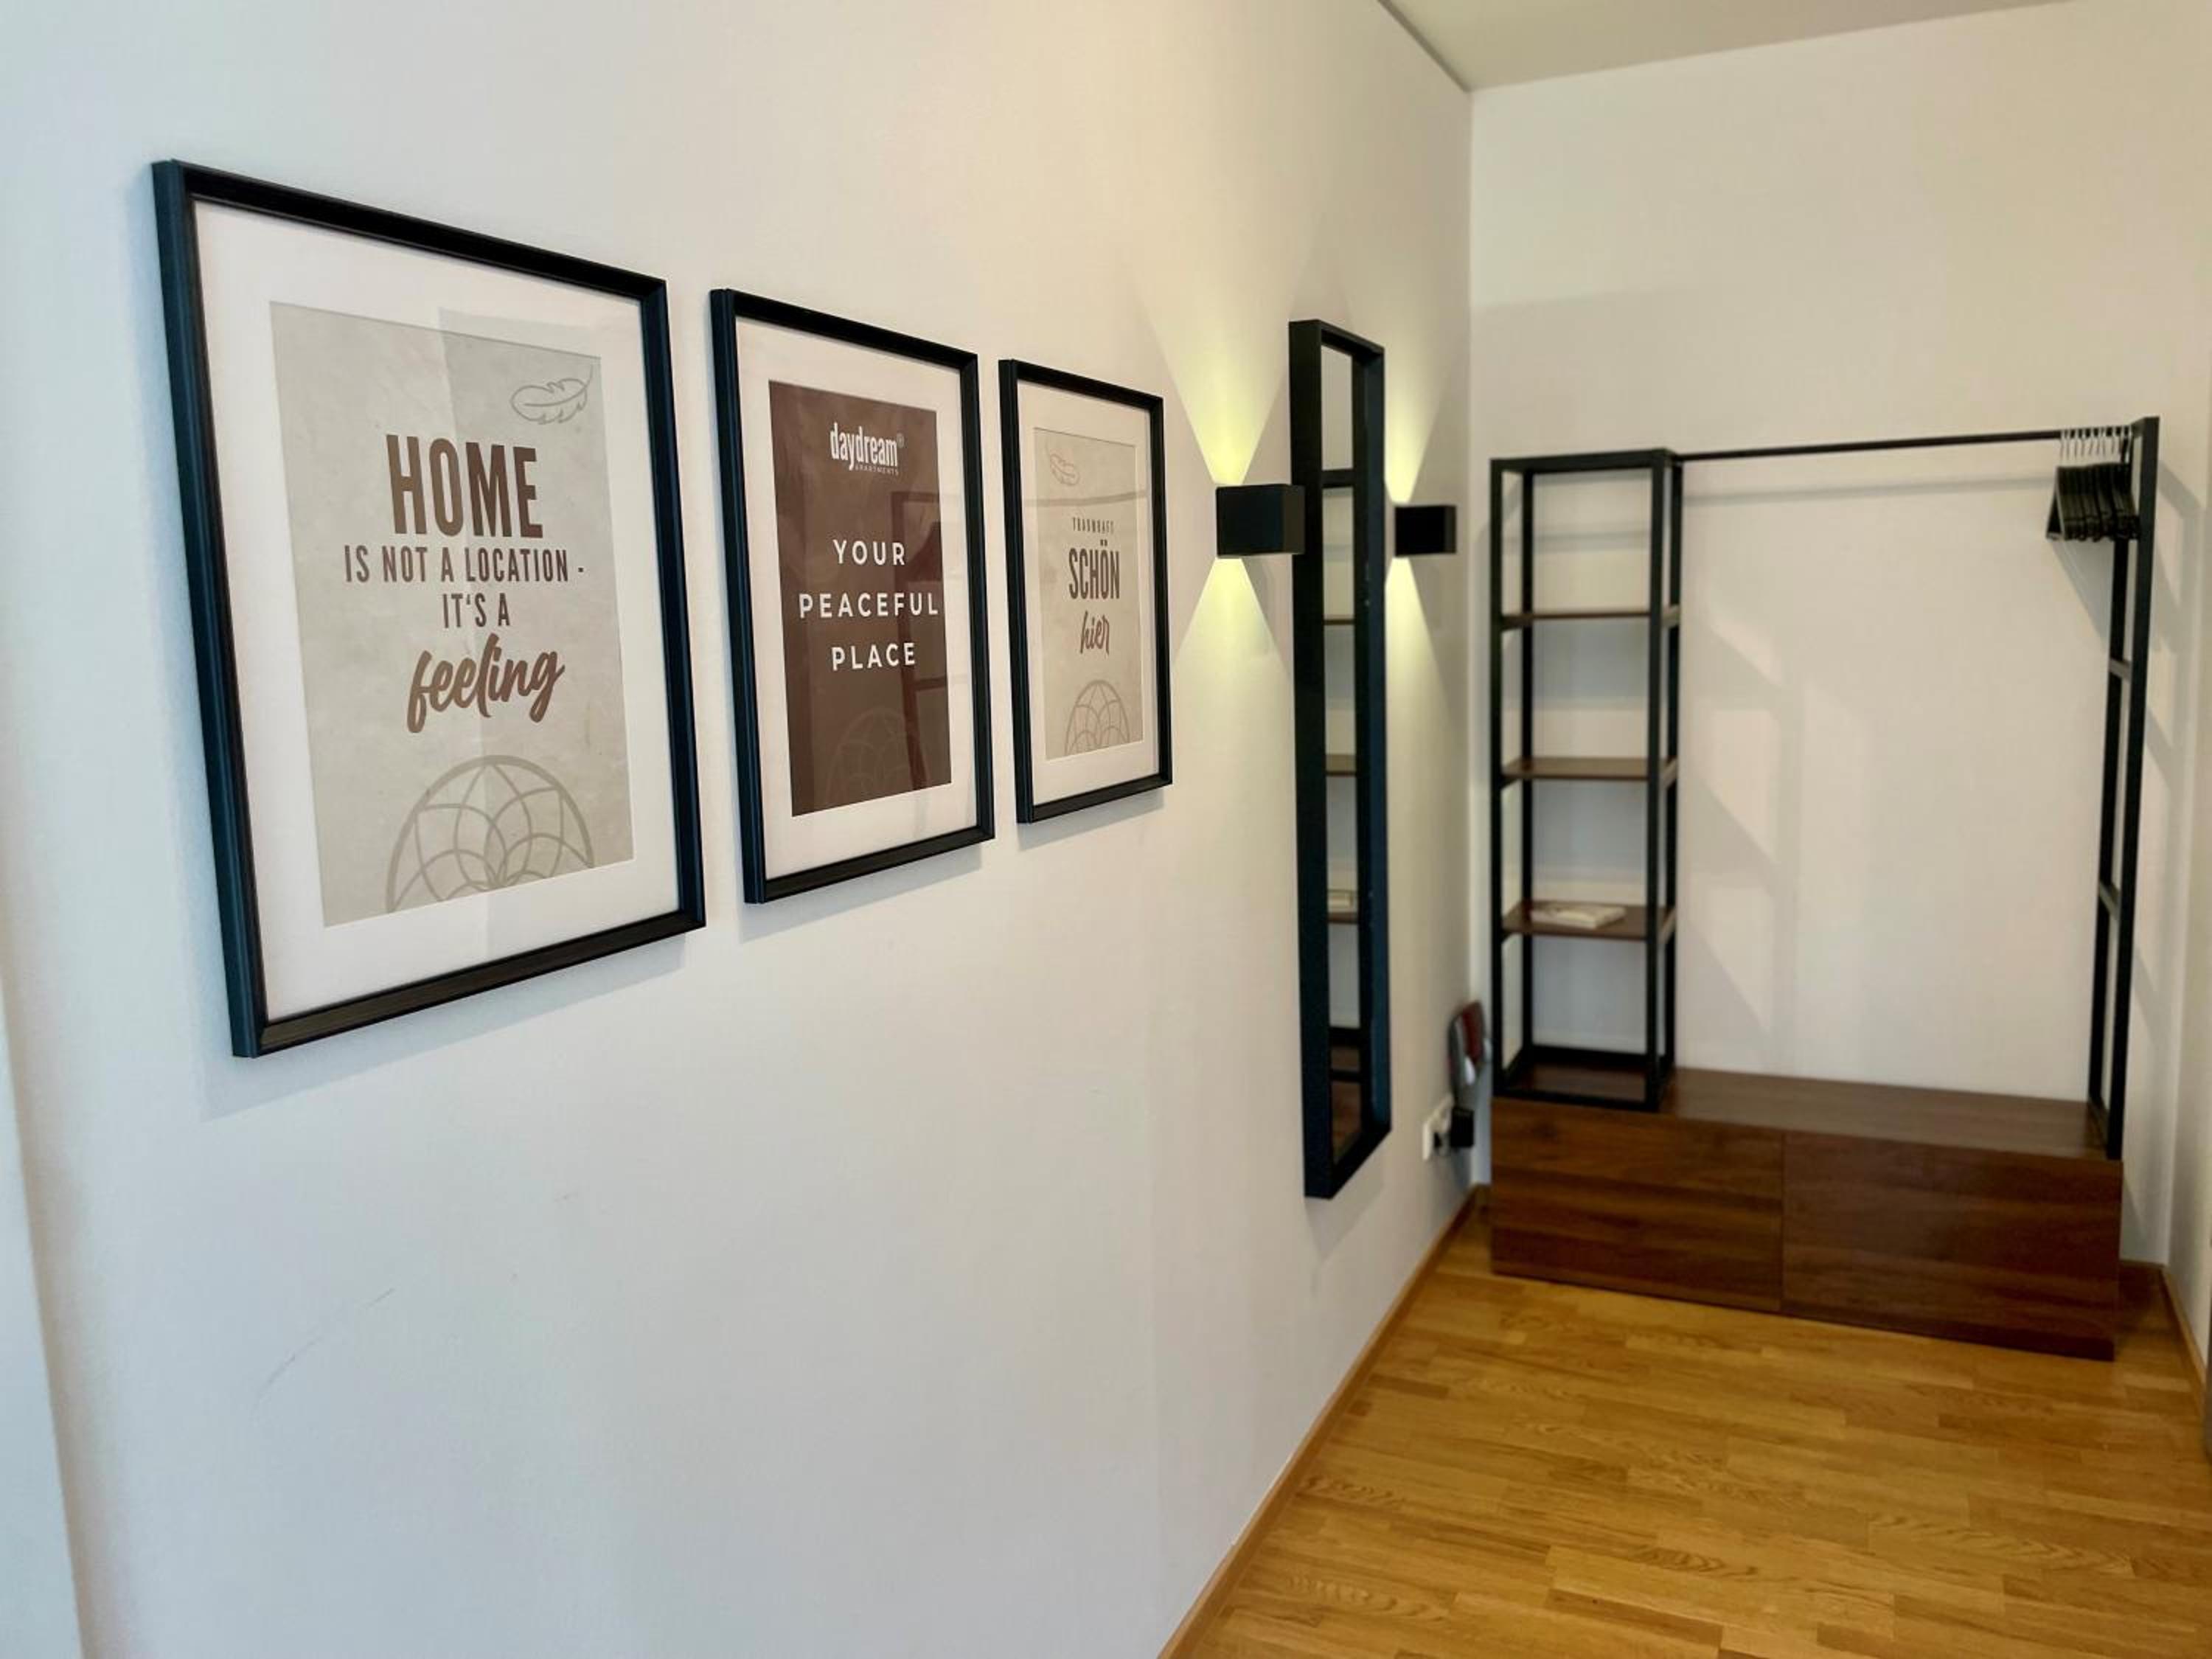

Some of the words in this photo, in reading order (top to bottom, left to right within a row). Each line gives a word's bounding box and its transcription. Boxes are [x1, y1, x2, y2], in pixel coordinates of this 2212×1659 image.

[386, 434, 543, 538] HOME
[344, 545, 370, 582] IS
[382, 546, 428, 582] NOT
[441, 547, 454, 582] A
[465, 547, 568, 582] LOCATION
[832, 539, 906, 566] YOUR
[1069, 539, 1120, 599] SCHÖN
[498, 592, 511, 627] A
[799, 592, 939, 619] PEACEFUL
[1079, 611, 1110, 655] hier
[832, 642, 916, 672] PLACE
[407, 633, 566, 734] feeling
